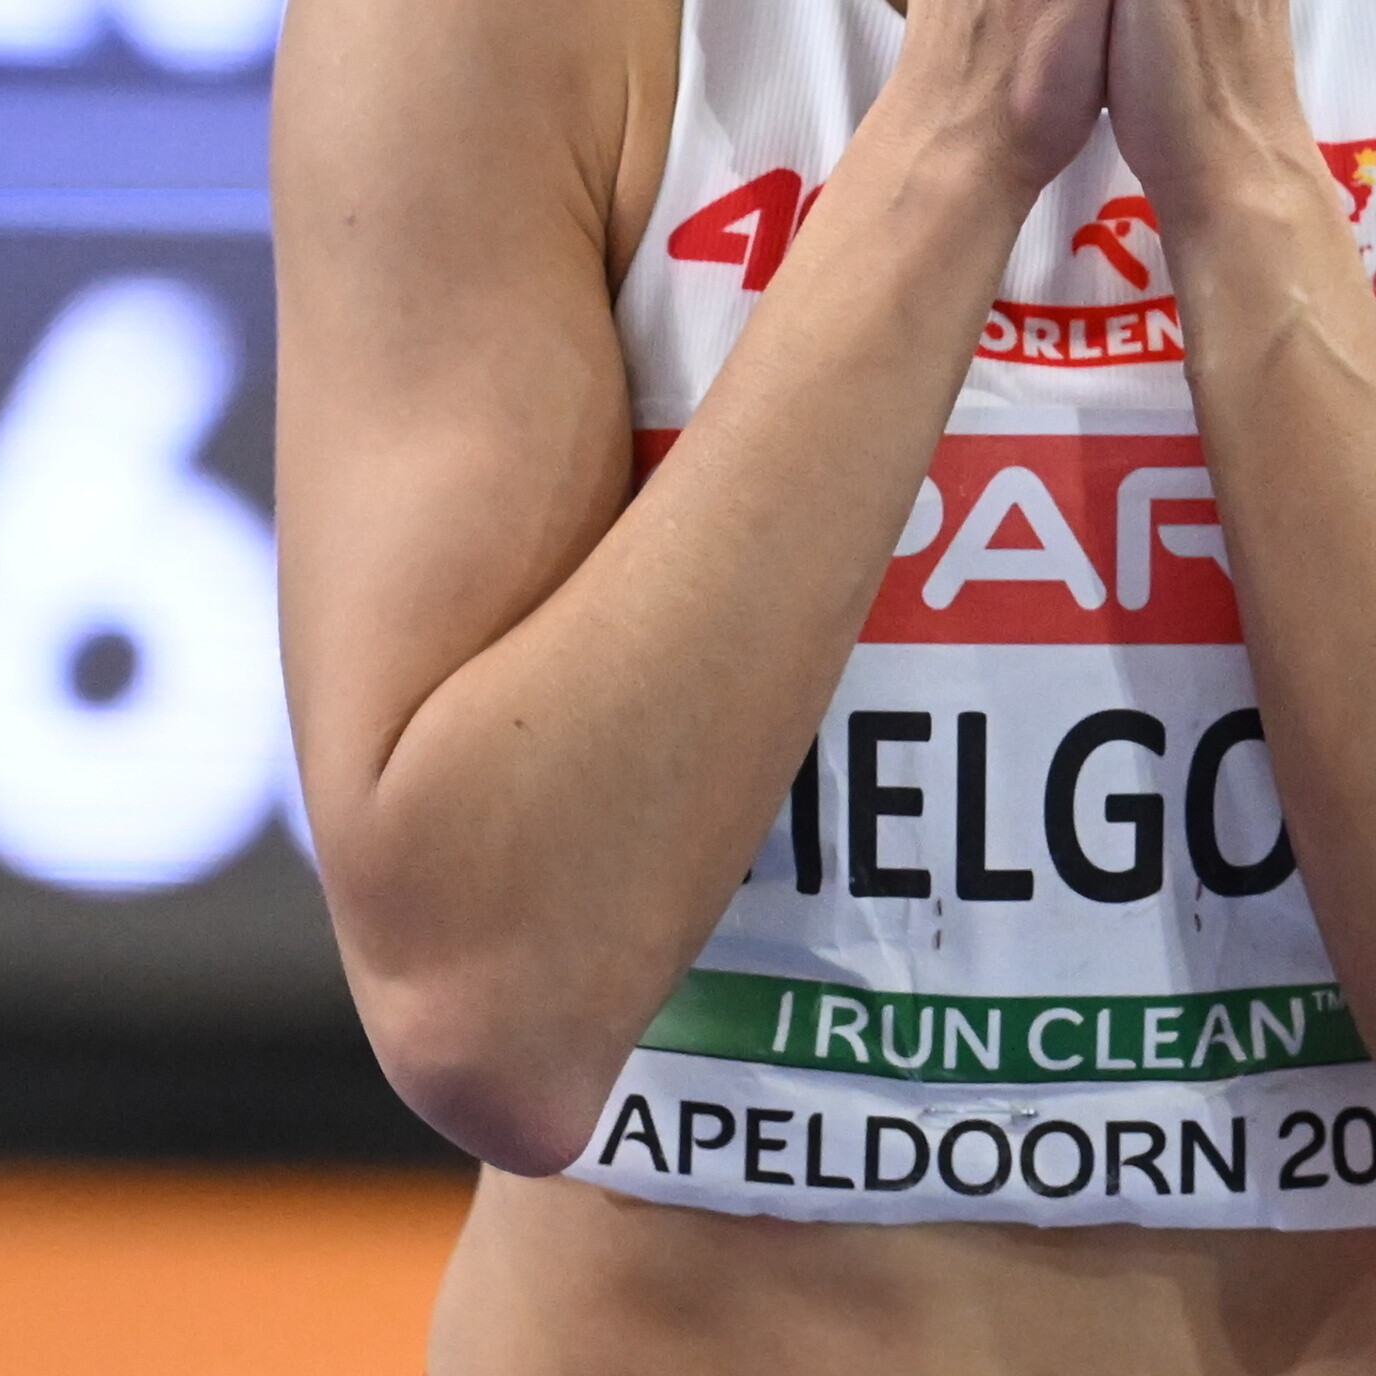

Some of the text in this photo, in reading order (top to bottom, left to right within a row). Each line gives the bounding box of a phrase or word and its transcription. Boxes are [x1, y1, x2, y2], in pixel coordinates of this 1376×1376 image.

[979, 309, 1185, 360] ORLEN
[773, 991, 794, 1053] I
[815, 994, 1002, 1070] RUN
[598, 1093, 1247, 1199] APELDOORN
